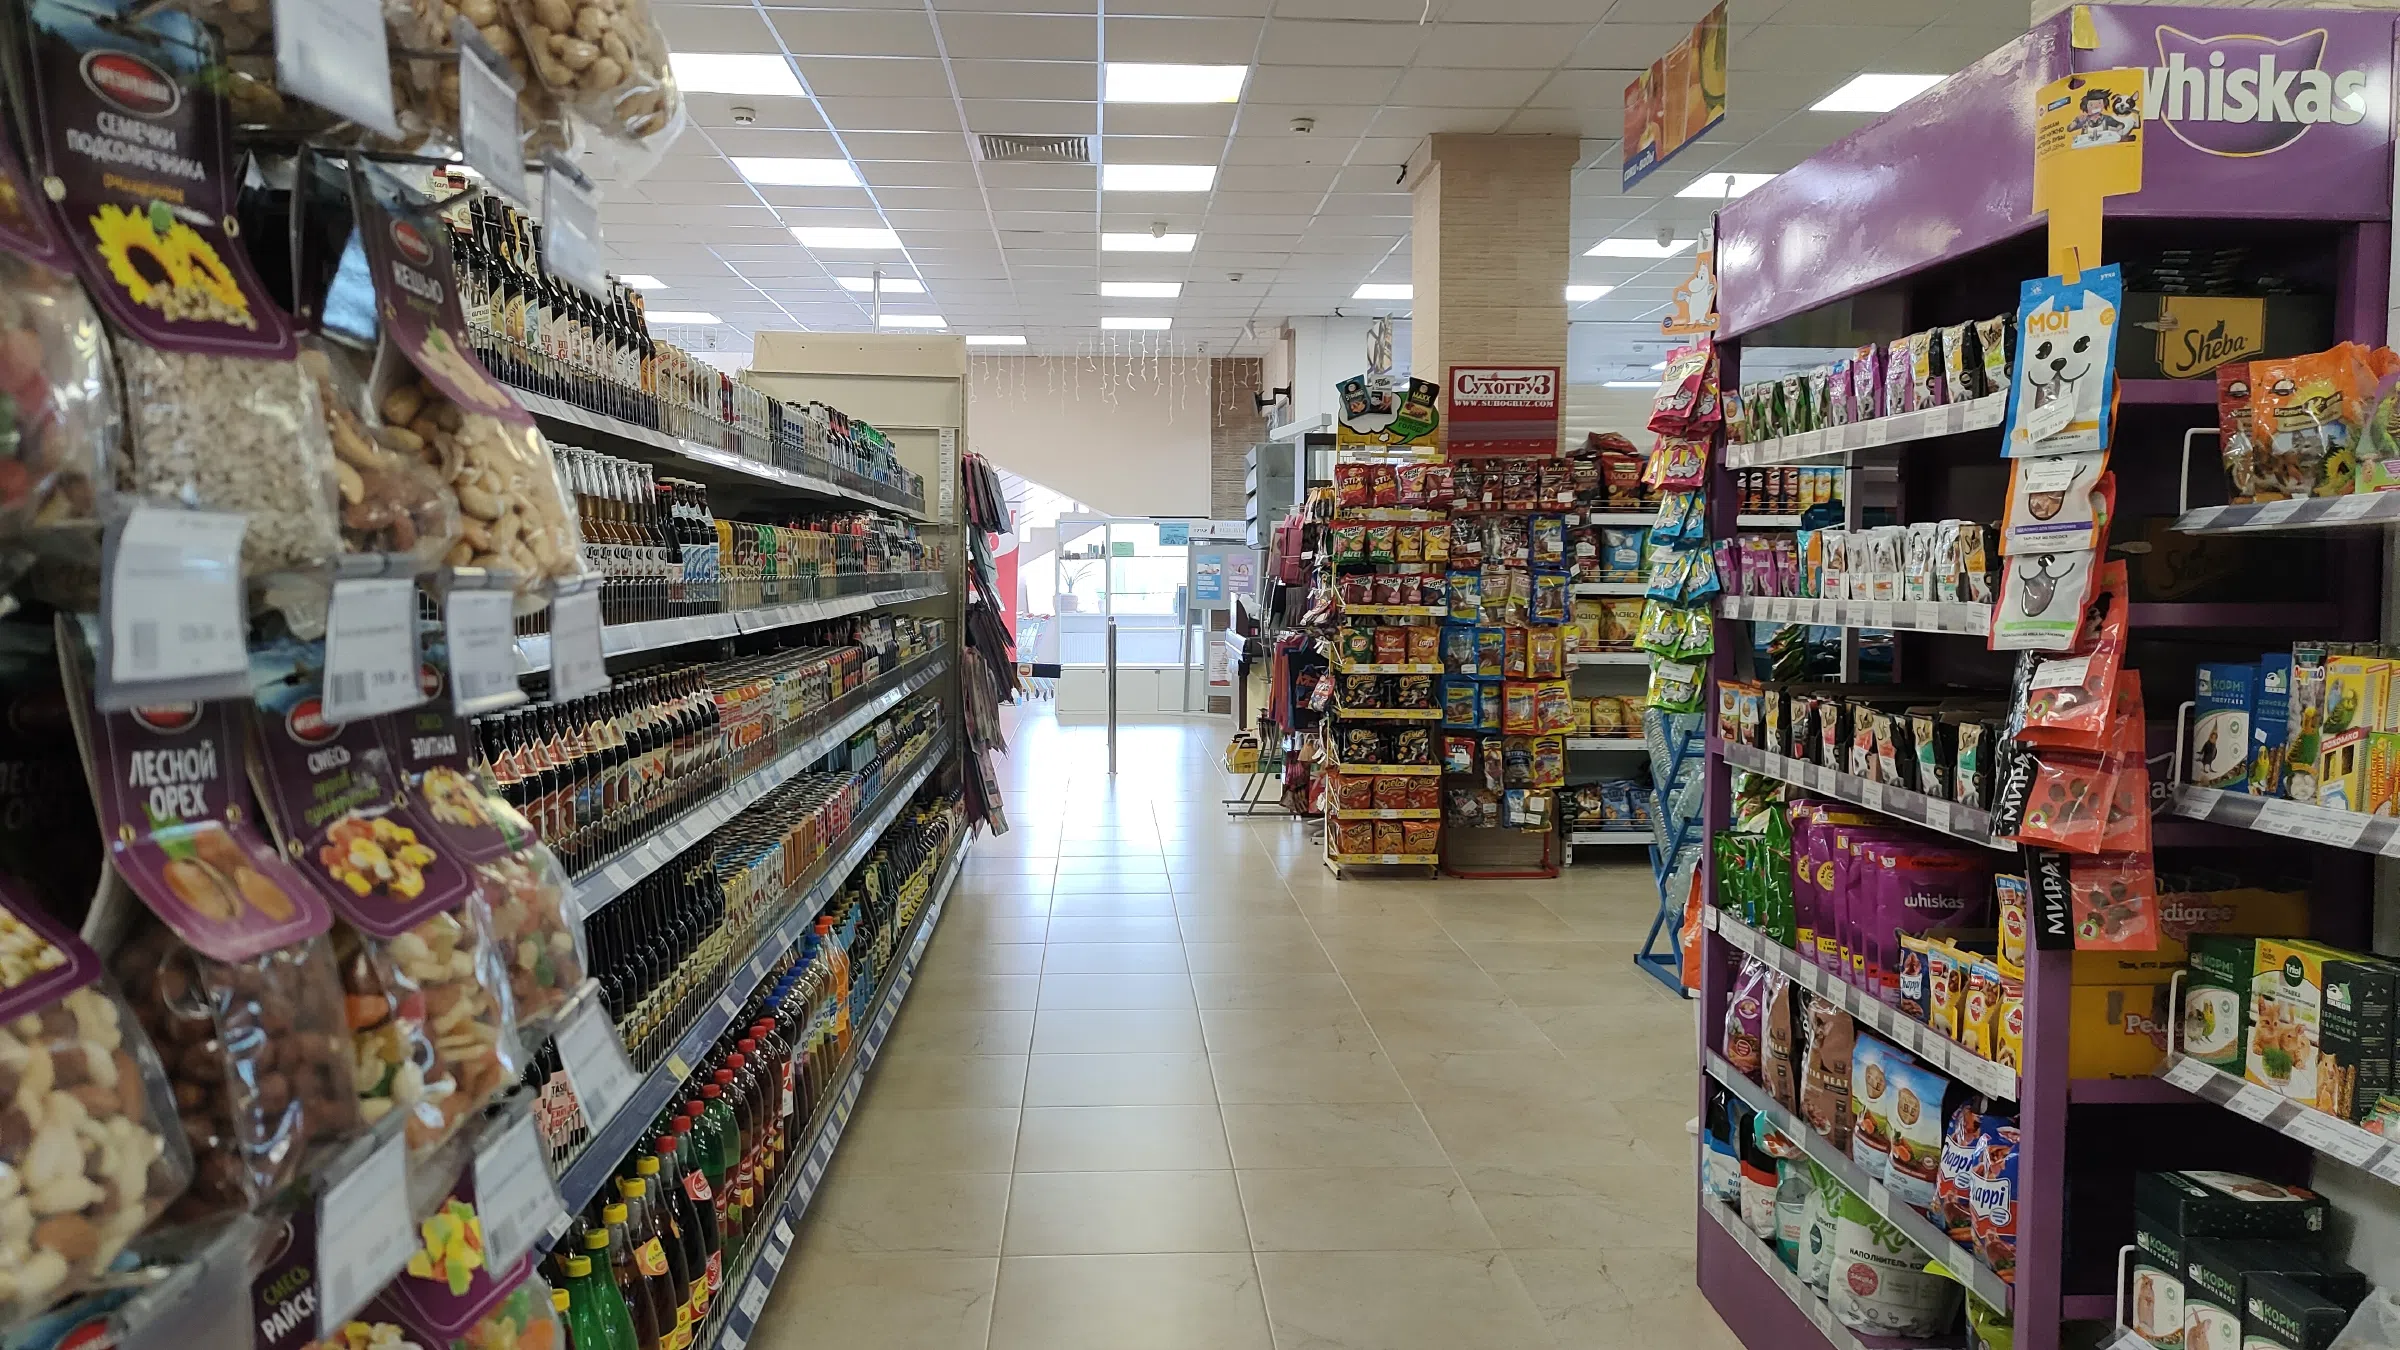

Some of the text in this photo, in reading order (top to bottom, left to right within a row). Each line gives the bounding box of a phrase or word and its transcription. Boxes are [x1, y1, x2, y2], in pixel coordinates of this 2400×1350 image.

[97, 112, 177, 150] СЕМЕЧКИ
[2176, 330, 2245, 372] Sheba
[1454, 400, 1554, 408] WWW.SUHOGRUZ.COM
[1343, 477, 1362, 485] STIX
[1375, 474, 1391, 484] STIX
[1610, 472, 1639, 480] NACHOS
[129, 740, 217, 787] ЛЕСНОЙ
[150, 783, 208, 821] ОРЕХ
[1904, 893, 1965, 909] whiskas
[2160, 903, 2232, 925] edigree
[2285, 963, 2301, 976] Triol
[1900, 975, 1921, 991] happi
[1823, 1073, 1849, 1088] MEAT
[1942, 1142, 1973, 1173] happi
[1849, 1248, 1908, 1269] НАПОЛНИТЕЛЬ
[2202, 1269, 2232, 1292] КОРМ
[2264, 1304, 2296, 1333] КОРМ
[2264, 1317, 2300, 1344] КРОЛИКОВ
